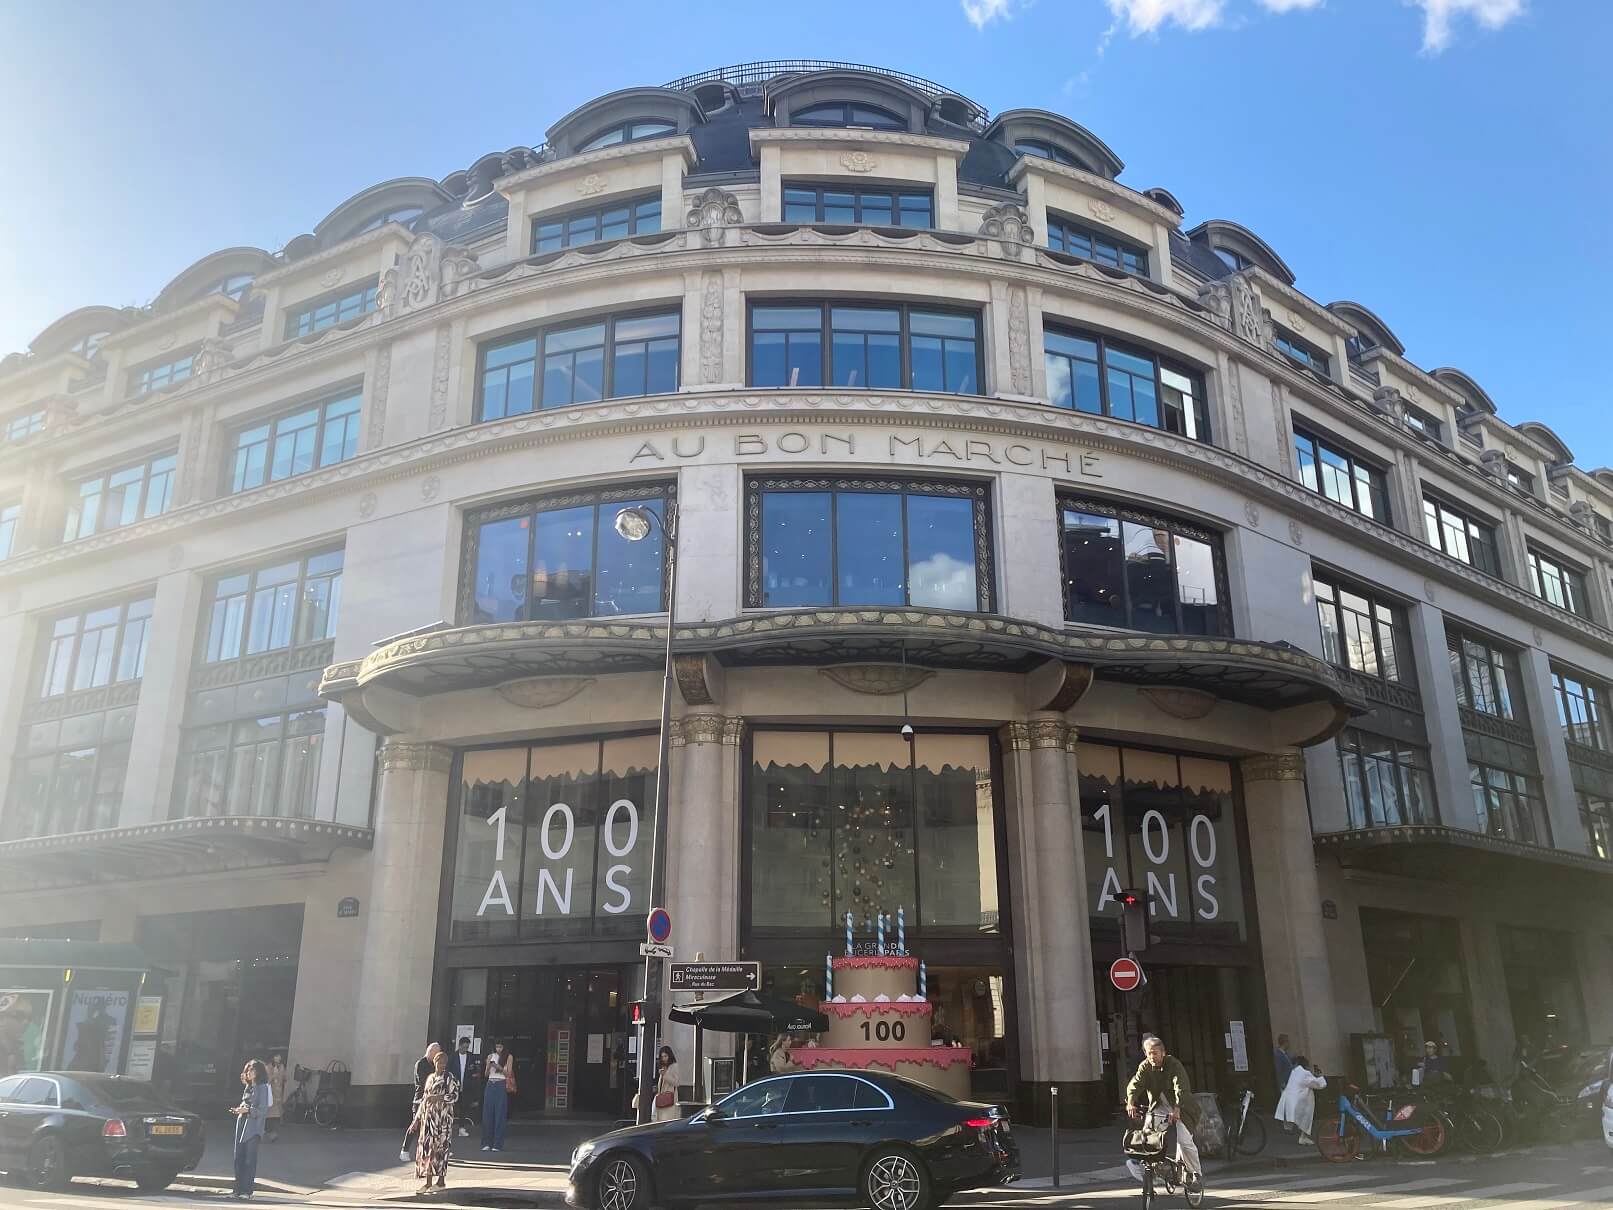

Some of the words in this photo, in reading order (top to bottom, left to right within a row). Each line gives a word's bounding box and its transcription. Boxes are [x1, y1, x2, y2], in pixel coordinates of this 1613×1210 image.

[628, 435, 706, 464] AU
[734, 431, 856, 457] BON
[888, 433, 1104, 478] MARCHÉ
[486, 799, 639, 861] 100
[1093, 804, 1217, 868] 100
[476, 864, 633, 916] ANS
[1097, 867, 1219, 920] ANS
[864, 942, 903, 950] GRND
[73, 991, 128, 1007] Numéro
[860, 1020, 905, 1042] 100
